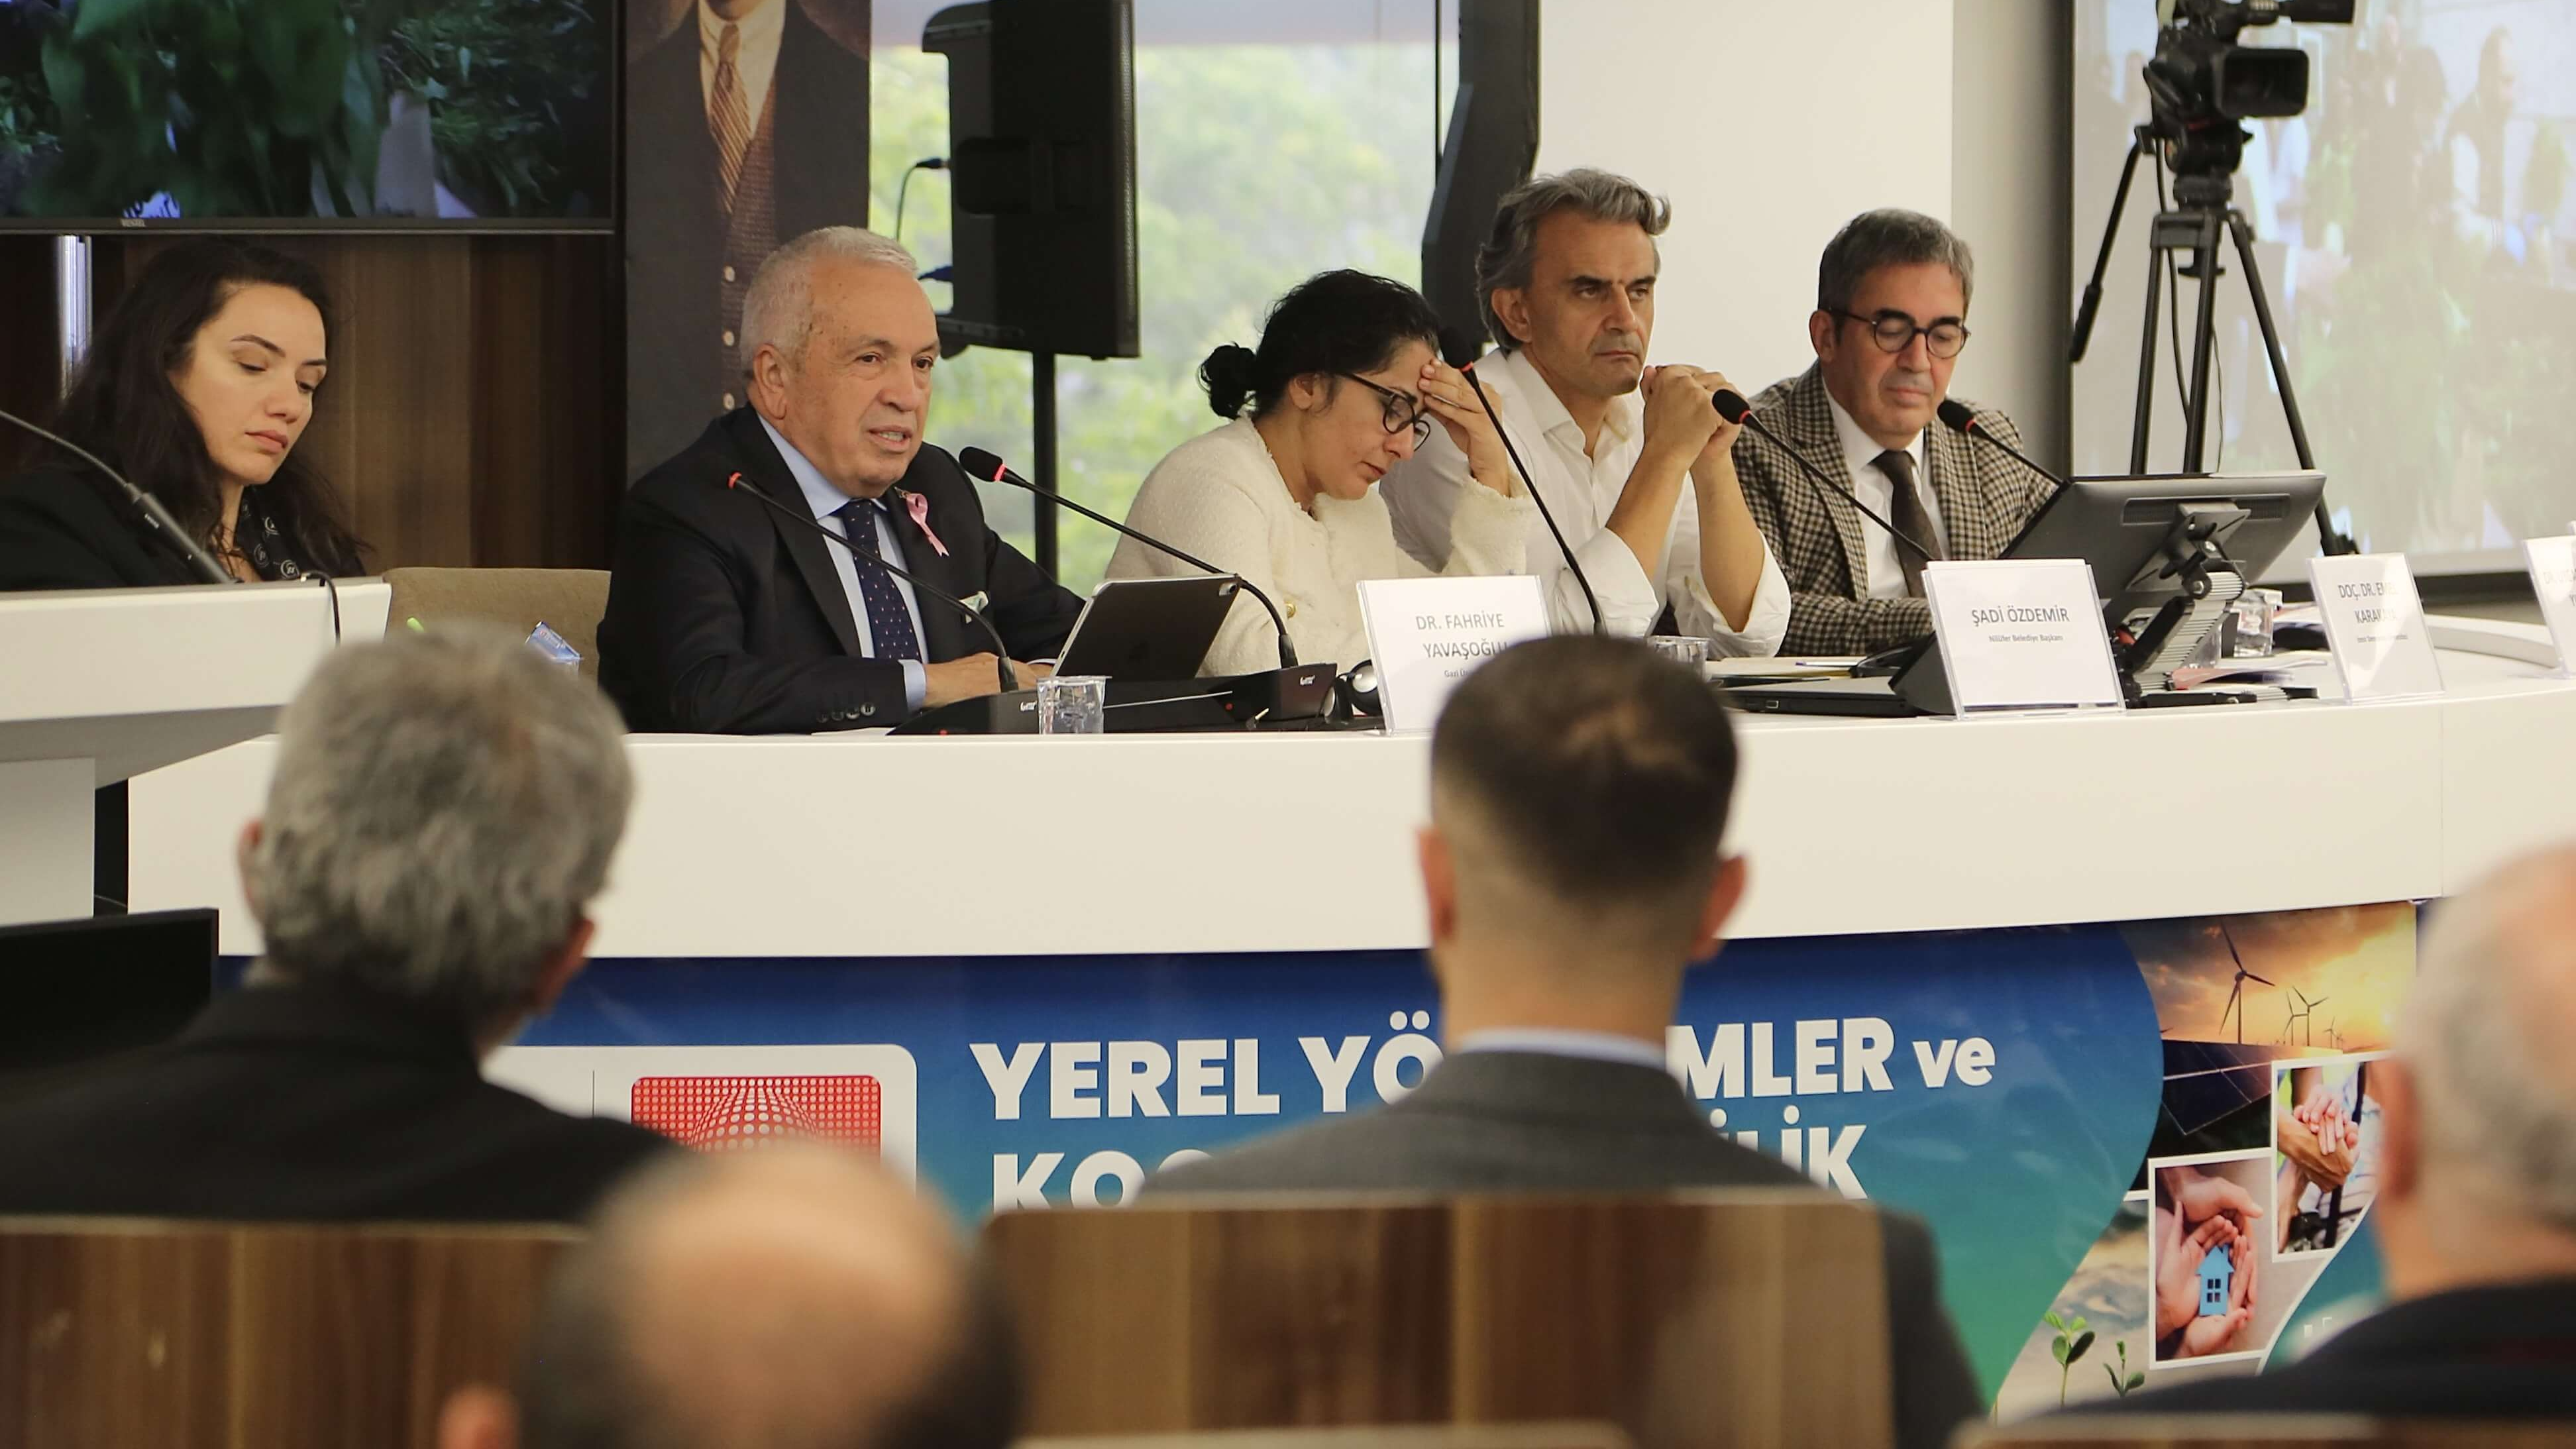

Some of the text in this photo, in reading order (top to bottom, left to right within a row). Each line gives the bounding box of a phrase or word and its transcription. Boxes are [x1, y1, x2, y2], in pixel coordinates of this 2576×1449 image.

[1416, 610, 1505, 630] DR. FAHRİYE
[1972, 605, 2070, 627] ŞADİ ÖZDEMİR
[969, 1038, 1280, 1120] YEREL
[1912, 1037, 1996, 1088] ve
